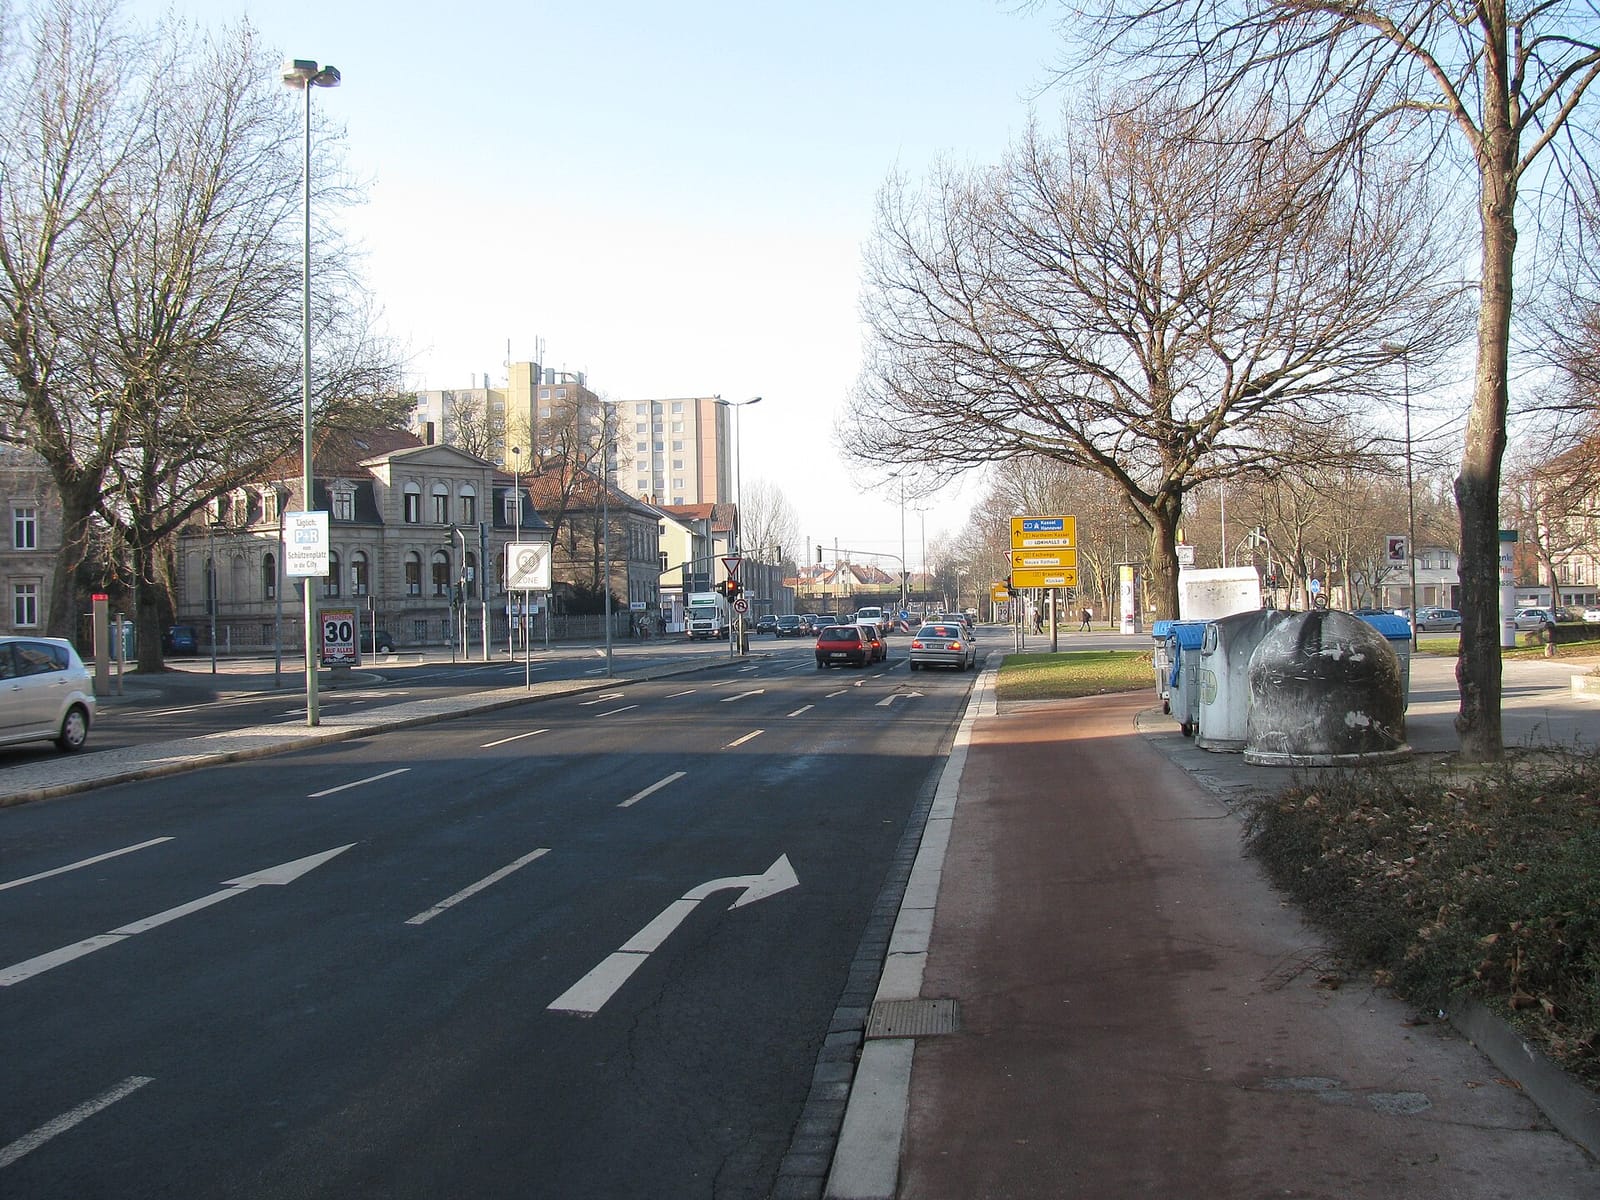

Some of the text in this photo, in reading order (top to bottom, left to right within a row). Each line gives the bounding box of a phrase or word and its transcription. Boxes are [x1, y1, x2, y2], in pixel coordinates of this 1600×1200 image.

[296, 530, 318, 543] P+R
[288, 551, 327, 560] Schützenplatz
[306, 560, 317, 568] City
[325, 621, 352, 642] 30
